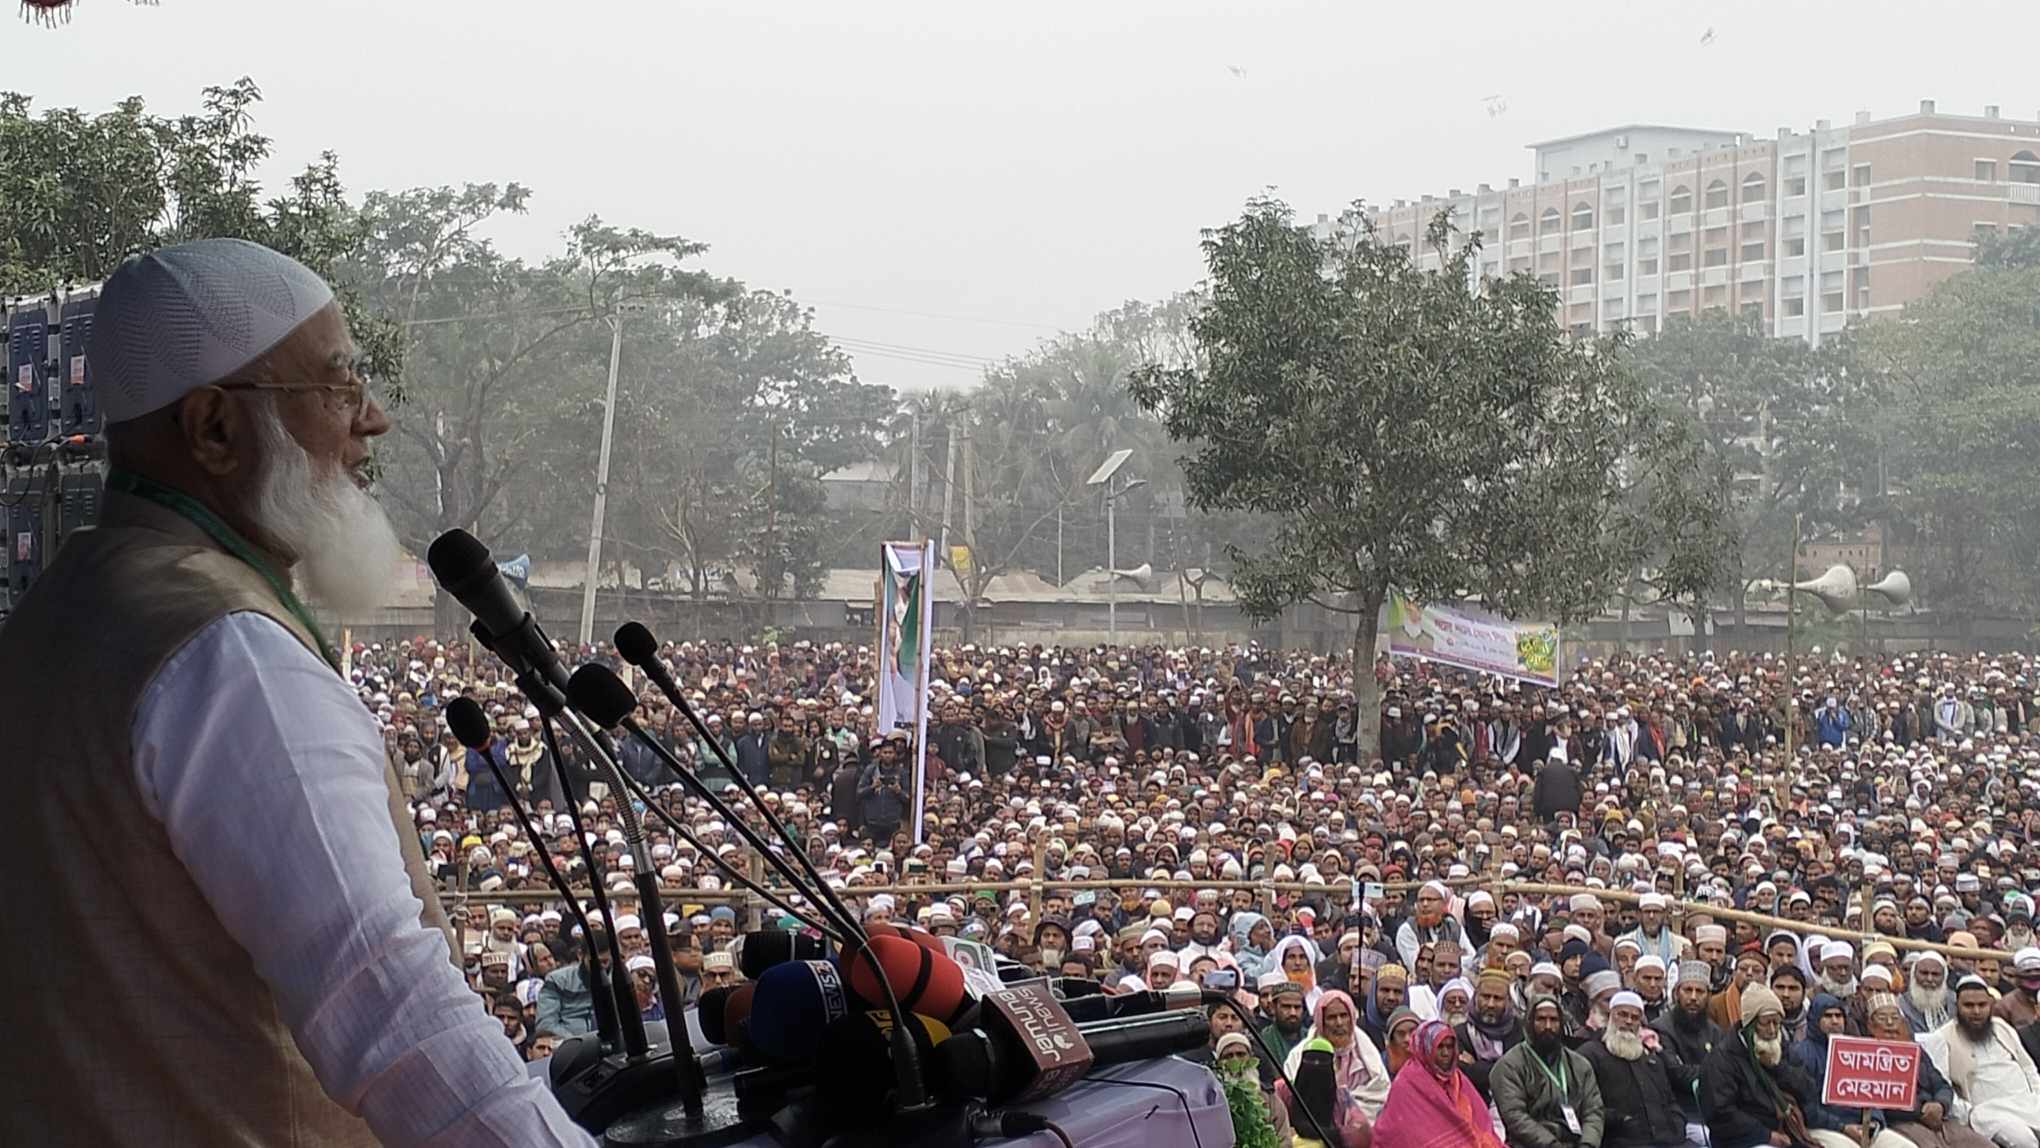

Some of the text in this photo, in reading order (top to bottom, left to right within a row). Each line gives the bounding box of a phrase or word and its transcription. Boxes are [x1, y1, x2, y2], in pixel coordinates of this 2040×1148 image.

[1018, 985, 1058, 1029] news
[1837, 1047, 1913, 1073] আমন্ত্রিত
[1836, 1077, 1909, 1101] মেহমান
